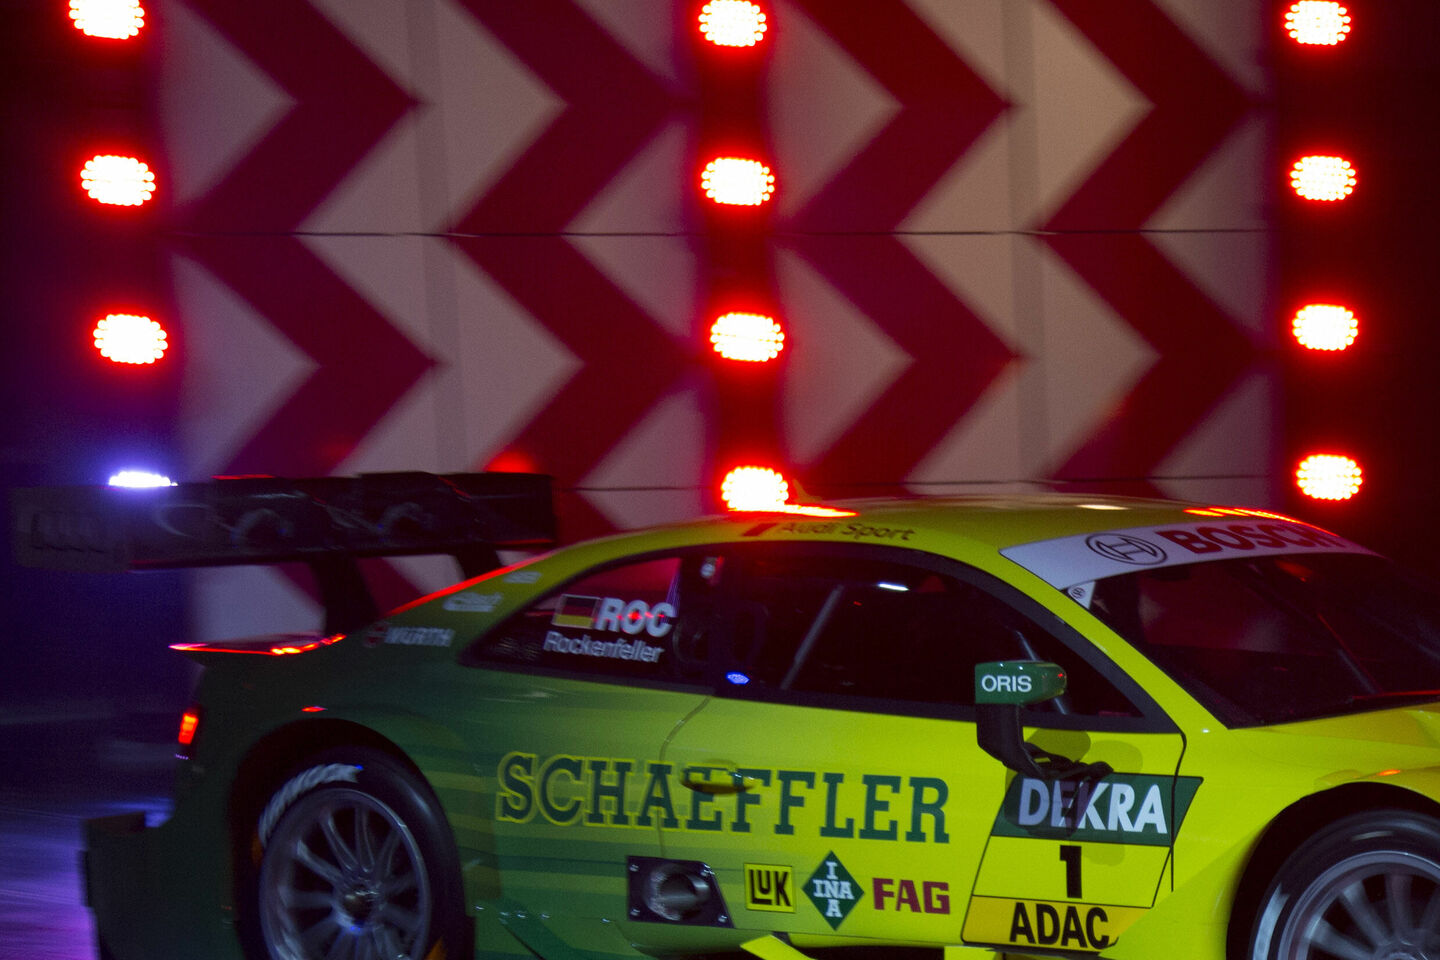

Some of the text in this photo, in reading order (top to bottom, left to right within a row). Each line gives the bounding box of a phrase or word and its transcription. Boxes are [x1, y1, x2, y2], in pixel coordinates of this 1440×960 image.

[842, 522, 915, 540] Sport
[594, 597, 679, 638] ROC
[543, 630, 666, 663] Rockenfeller
[981, 674, 1032, 693] ORIS
[497, 751, 950, 844] SCHAEFFLER
[1018, 777, 1168, 835] DEKRA
[1059, 845, 1082, 899] 1
[873, 877, 951, 915] FAG
[1009, 902, 1110, 948] ADAC
